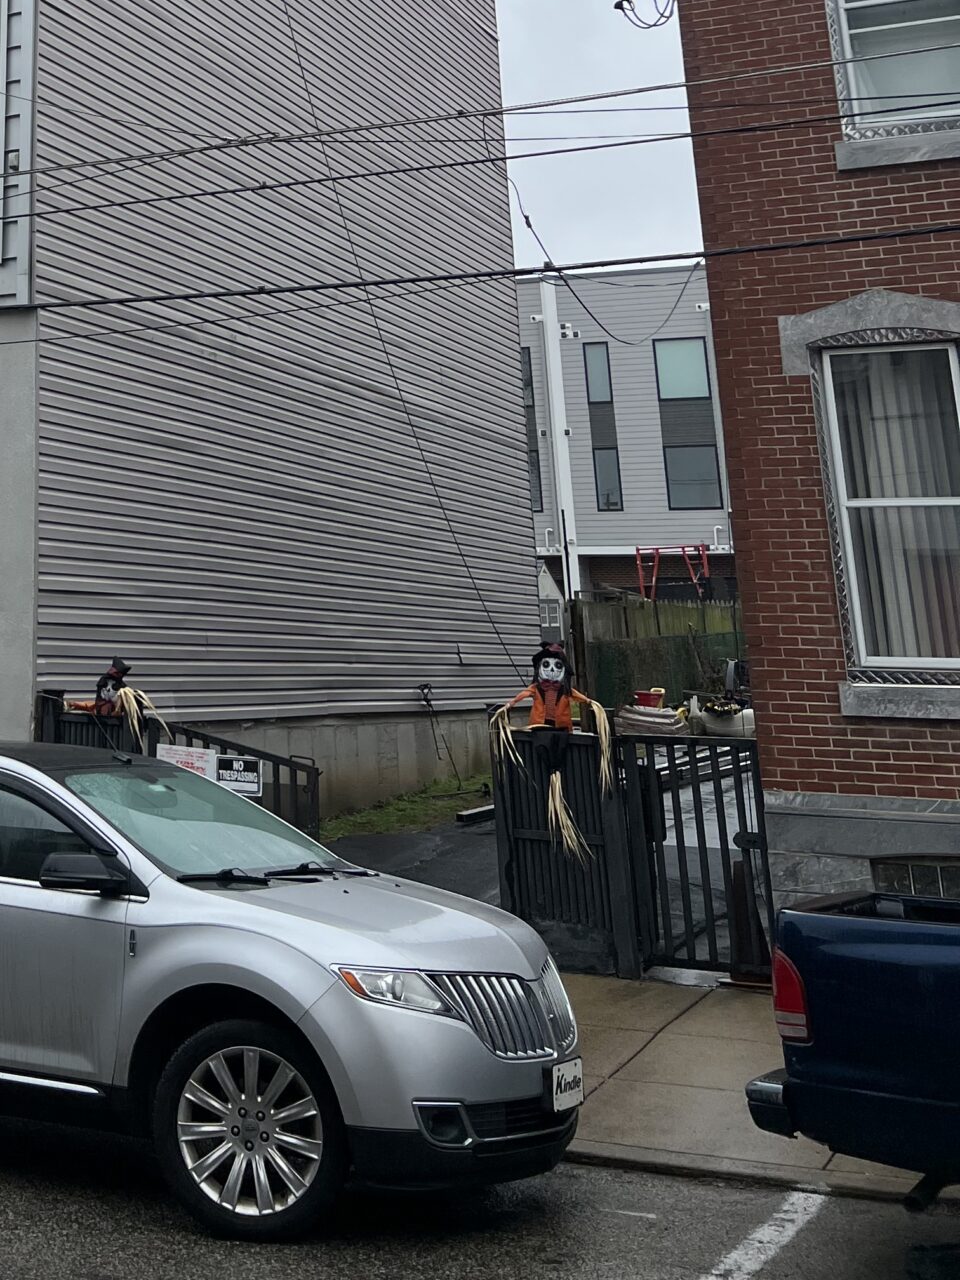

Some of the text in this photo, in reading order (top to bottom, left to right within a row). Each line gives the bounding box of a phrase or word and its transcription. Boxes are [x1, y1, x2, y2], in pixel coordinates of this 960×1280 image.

[233, 760, 244, 771] NO
[219, 769, 258, 783] TRESPASSING
[555, 1073, 582, 1095] Kindle
